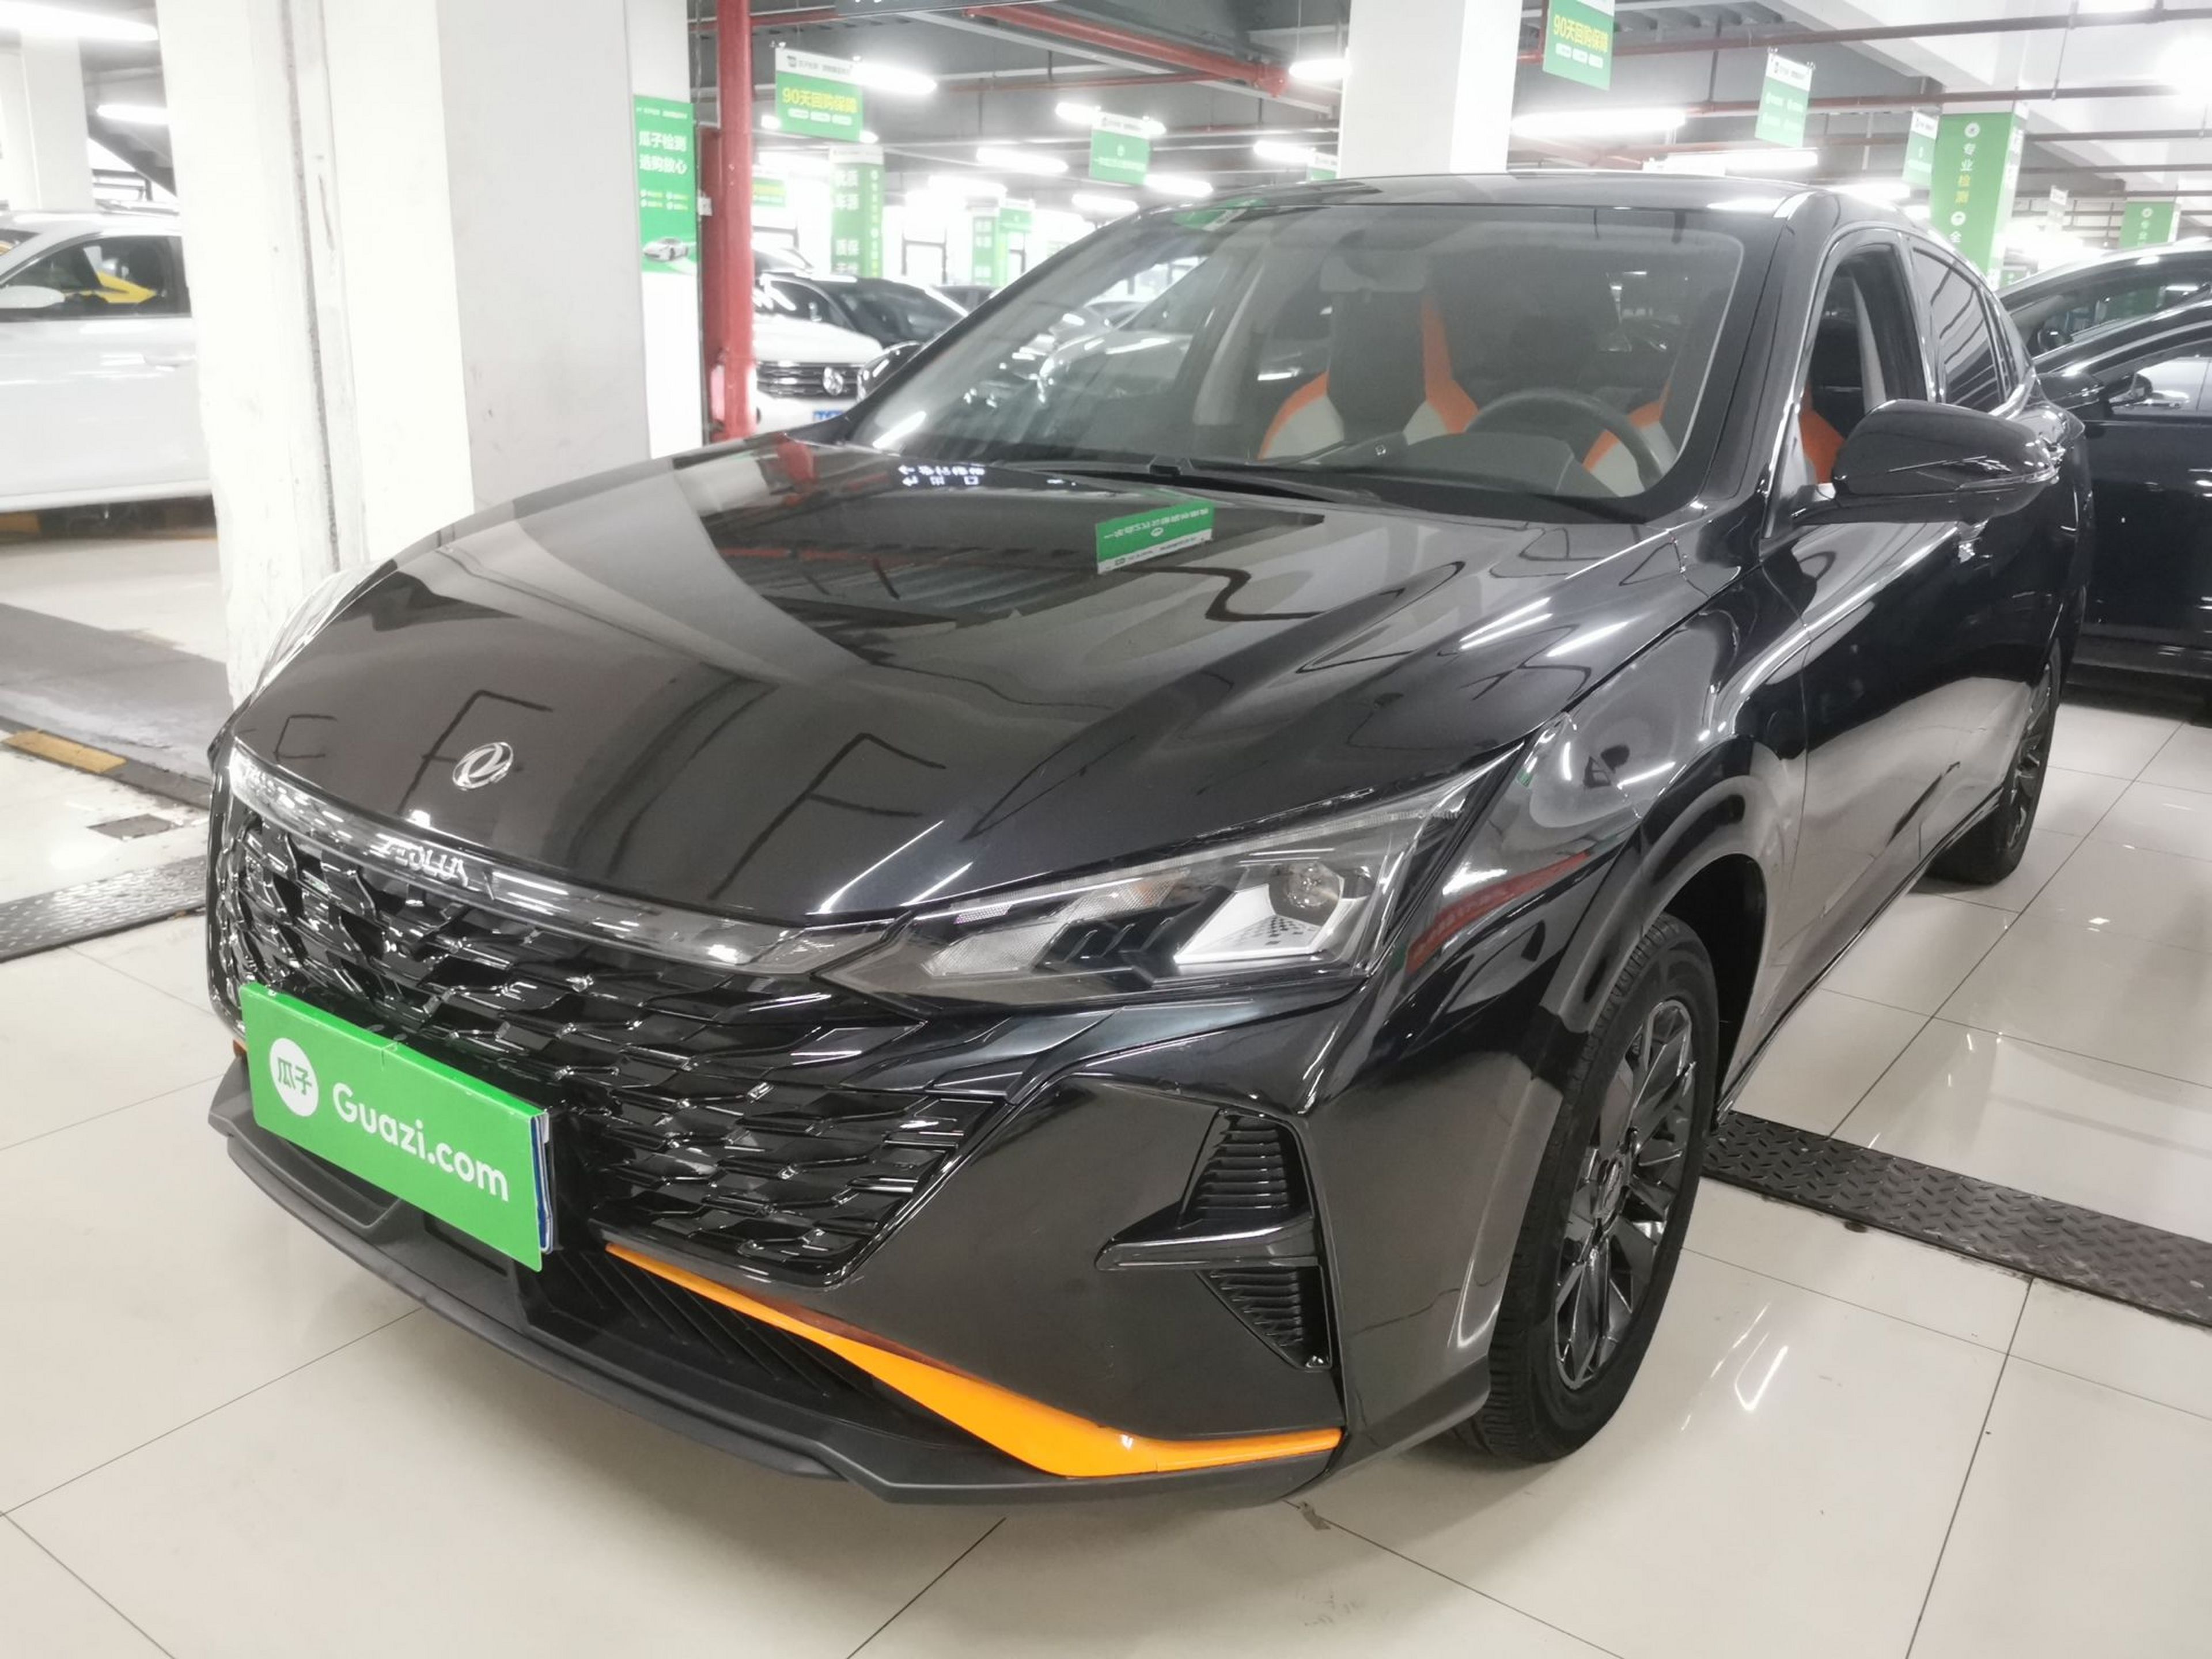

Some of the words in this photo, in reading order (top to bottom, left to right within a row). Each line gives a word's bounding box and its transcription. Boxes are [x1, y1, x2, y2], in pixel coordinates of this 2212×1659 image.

[1955, 143, 1976, 205] 专业检测
[276, 1056, 313, 1096] 瓜子
[332, 1082, 509, 1203] Guazi.com
